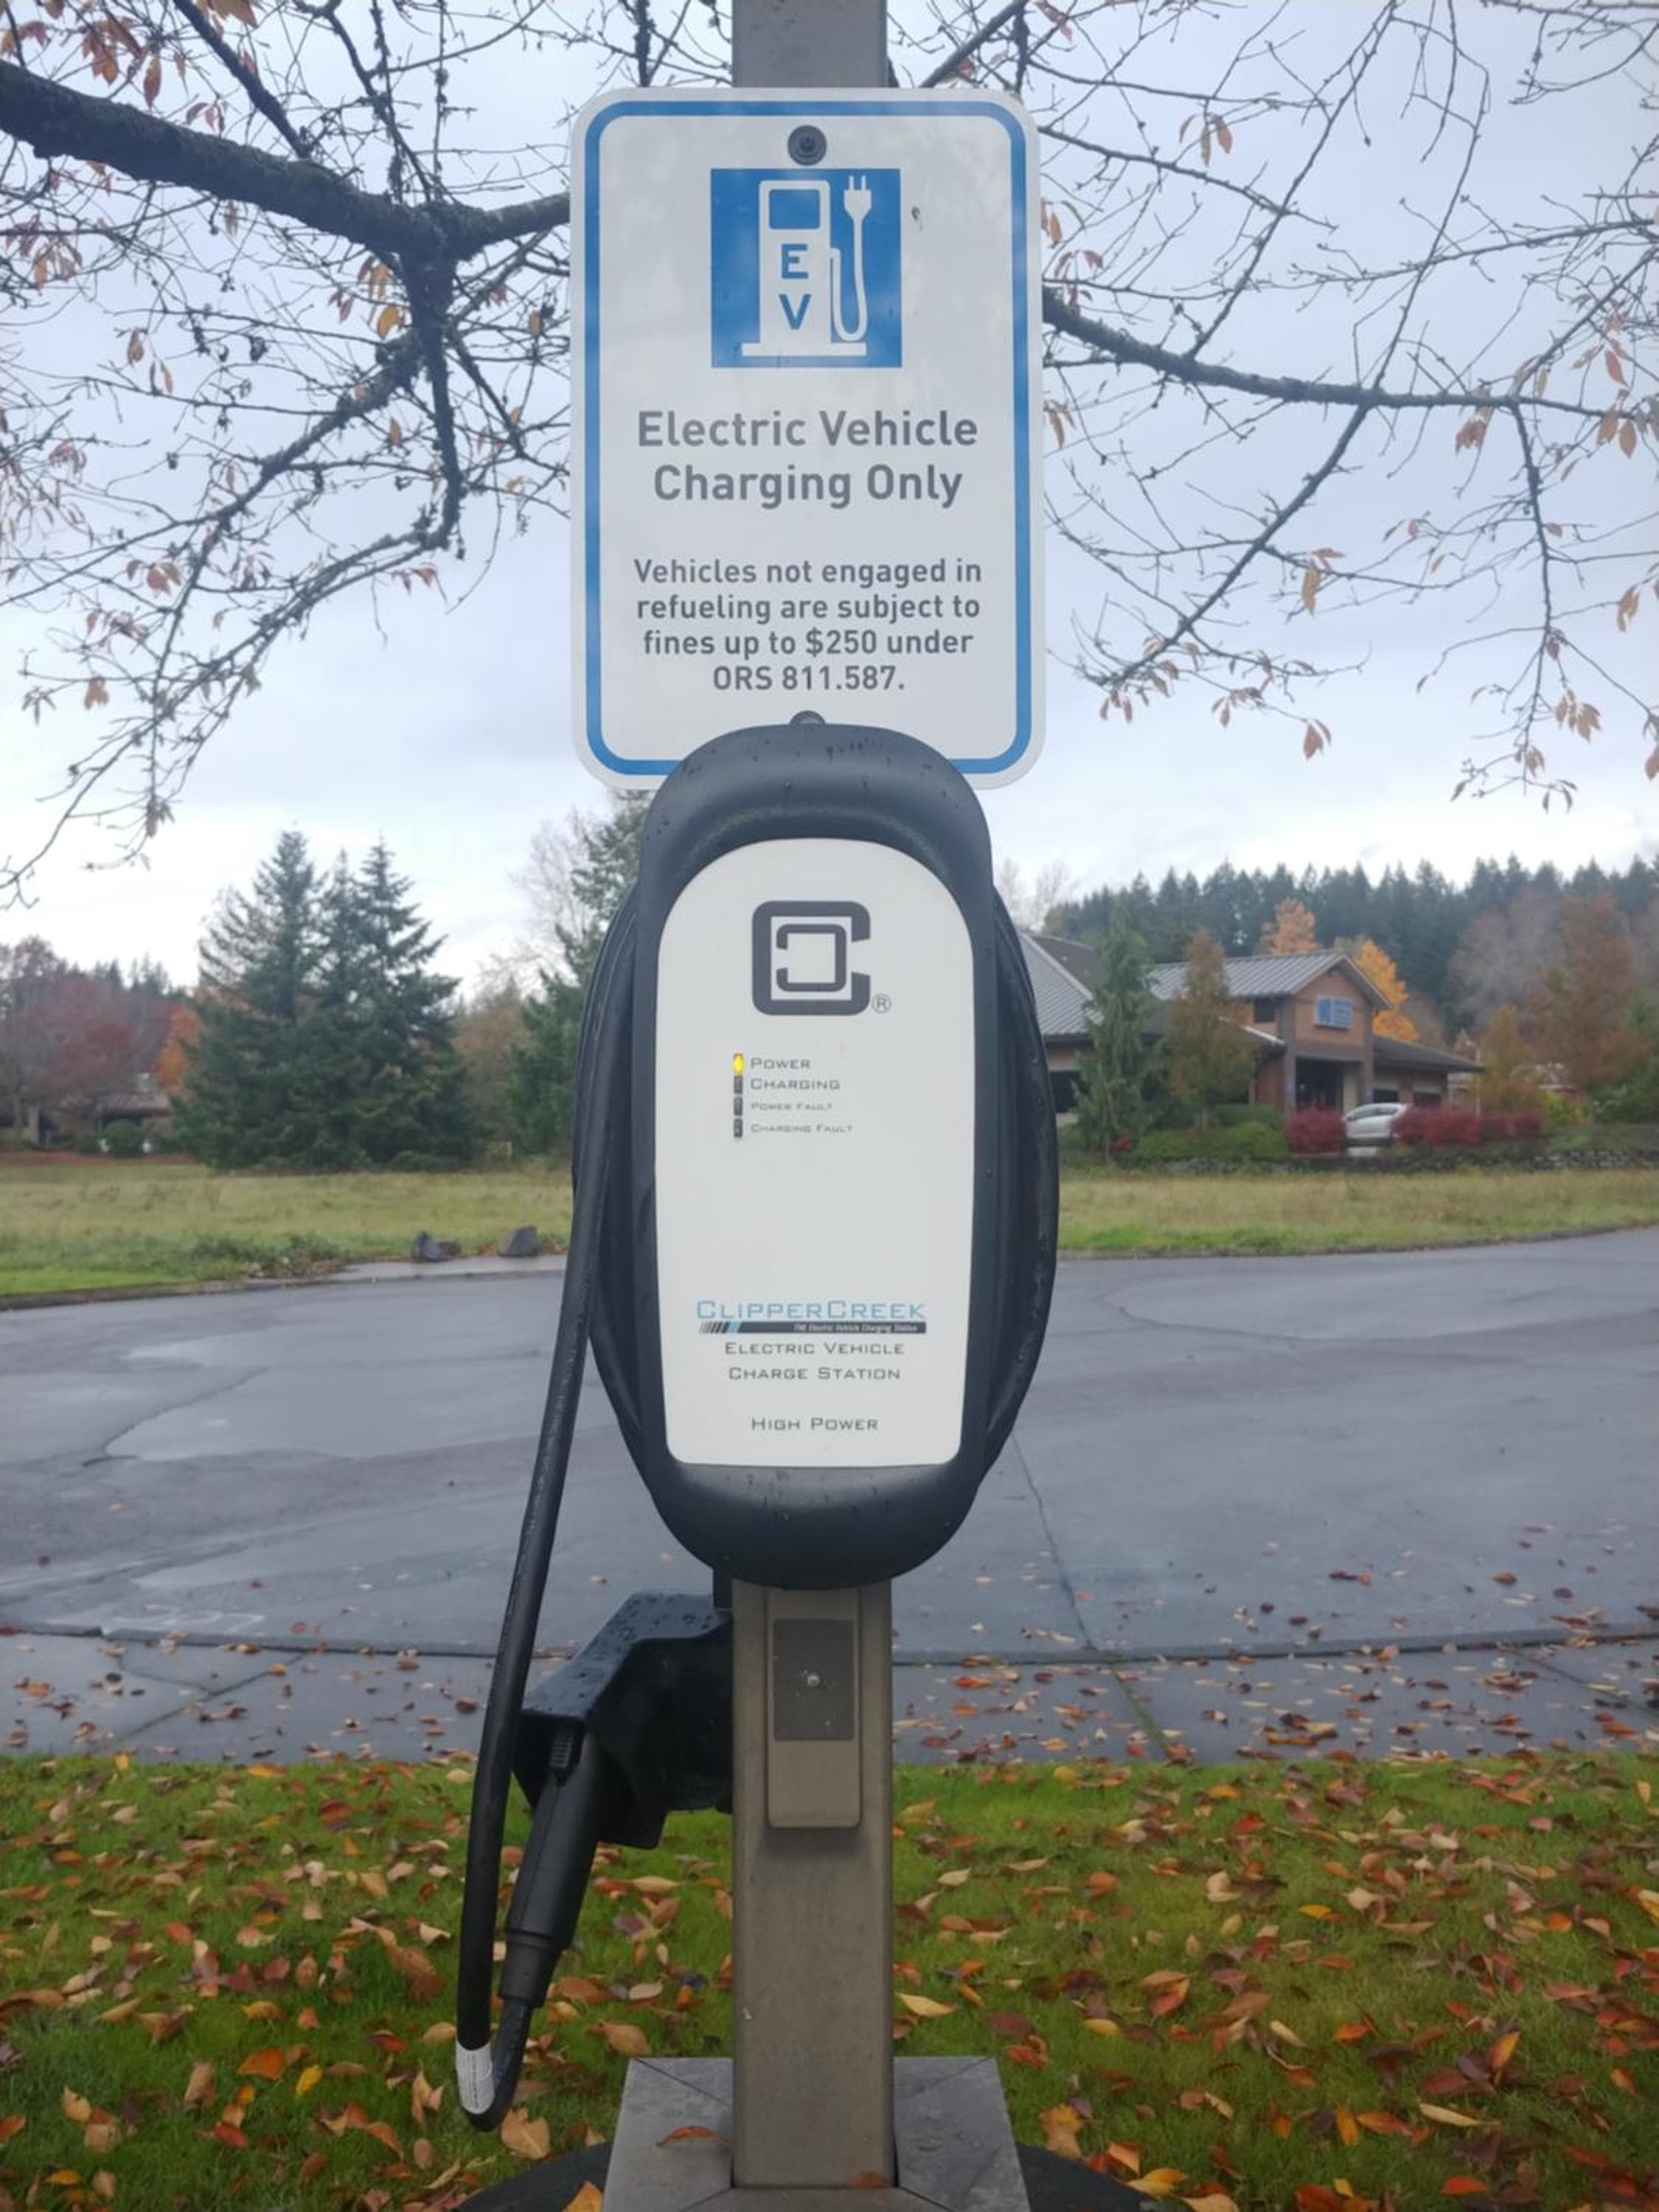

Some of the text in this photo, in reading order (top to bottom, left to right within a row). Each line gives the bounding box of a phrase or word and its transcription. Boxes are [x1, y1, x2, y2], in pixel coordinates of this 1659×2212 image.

[639, 411, 977, 446] Electric Vehicle
[655, 465, 962, 509] Charging Only
[634, 558, 981, 588] Vehicles not engaged in
[638, 594, 979, 625] refueling are subject to
[644, 627, 973, 660] fines up to $250 under
[714, 665, 904, 690] ORS 811.587.
[751, 1057, 810, 1069] POWER
[751, 1078, 840, 1090] CHARGING
[751, 1102, 832, 1110] POWER FAULT
[751, 1124, 852, 1133] CHARGING FAULT
[726, 1342, 903, 1354] ELECTRIC VEHICLE
[729, 1367, 900, 1380] CHARGE STATION
[752, 1418, 877, 1430] HIGH POWER
